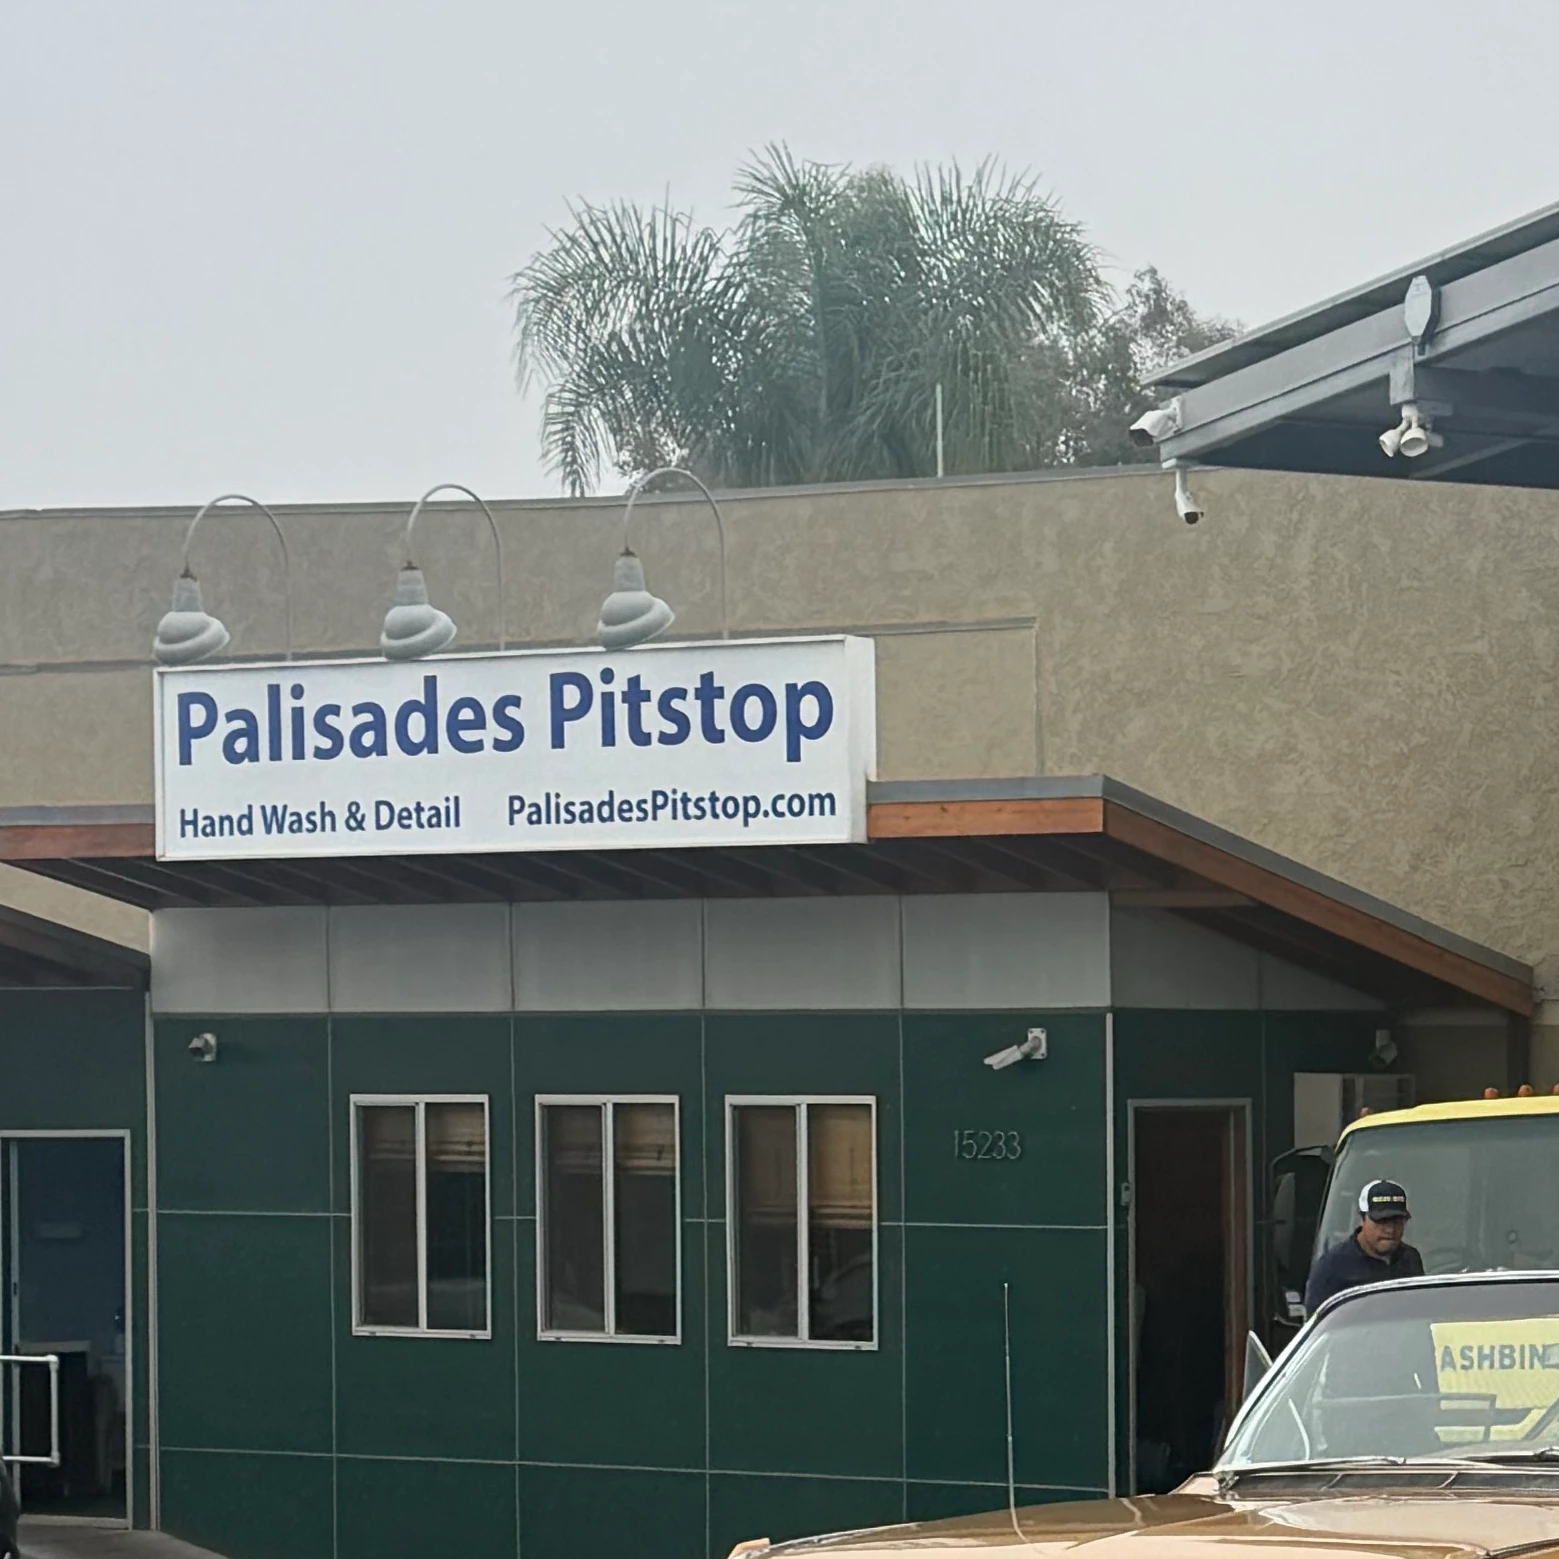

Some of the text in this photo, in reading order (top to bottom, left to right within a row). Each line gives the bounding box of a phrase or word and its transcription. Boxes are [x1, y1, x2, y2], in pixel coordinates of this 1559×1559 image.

[177, 667, 835, 766] Palisades Pitstop
[179, 795, 461, 839] Hand Wash & Detail
[508, 789, 837, 827] PalisadesPitstop.com
[953, 1129, 1022, 1160] 15233
[1440, 1343, 1546, 1372] ASHBIN
